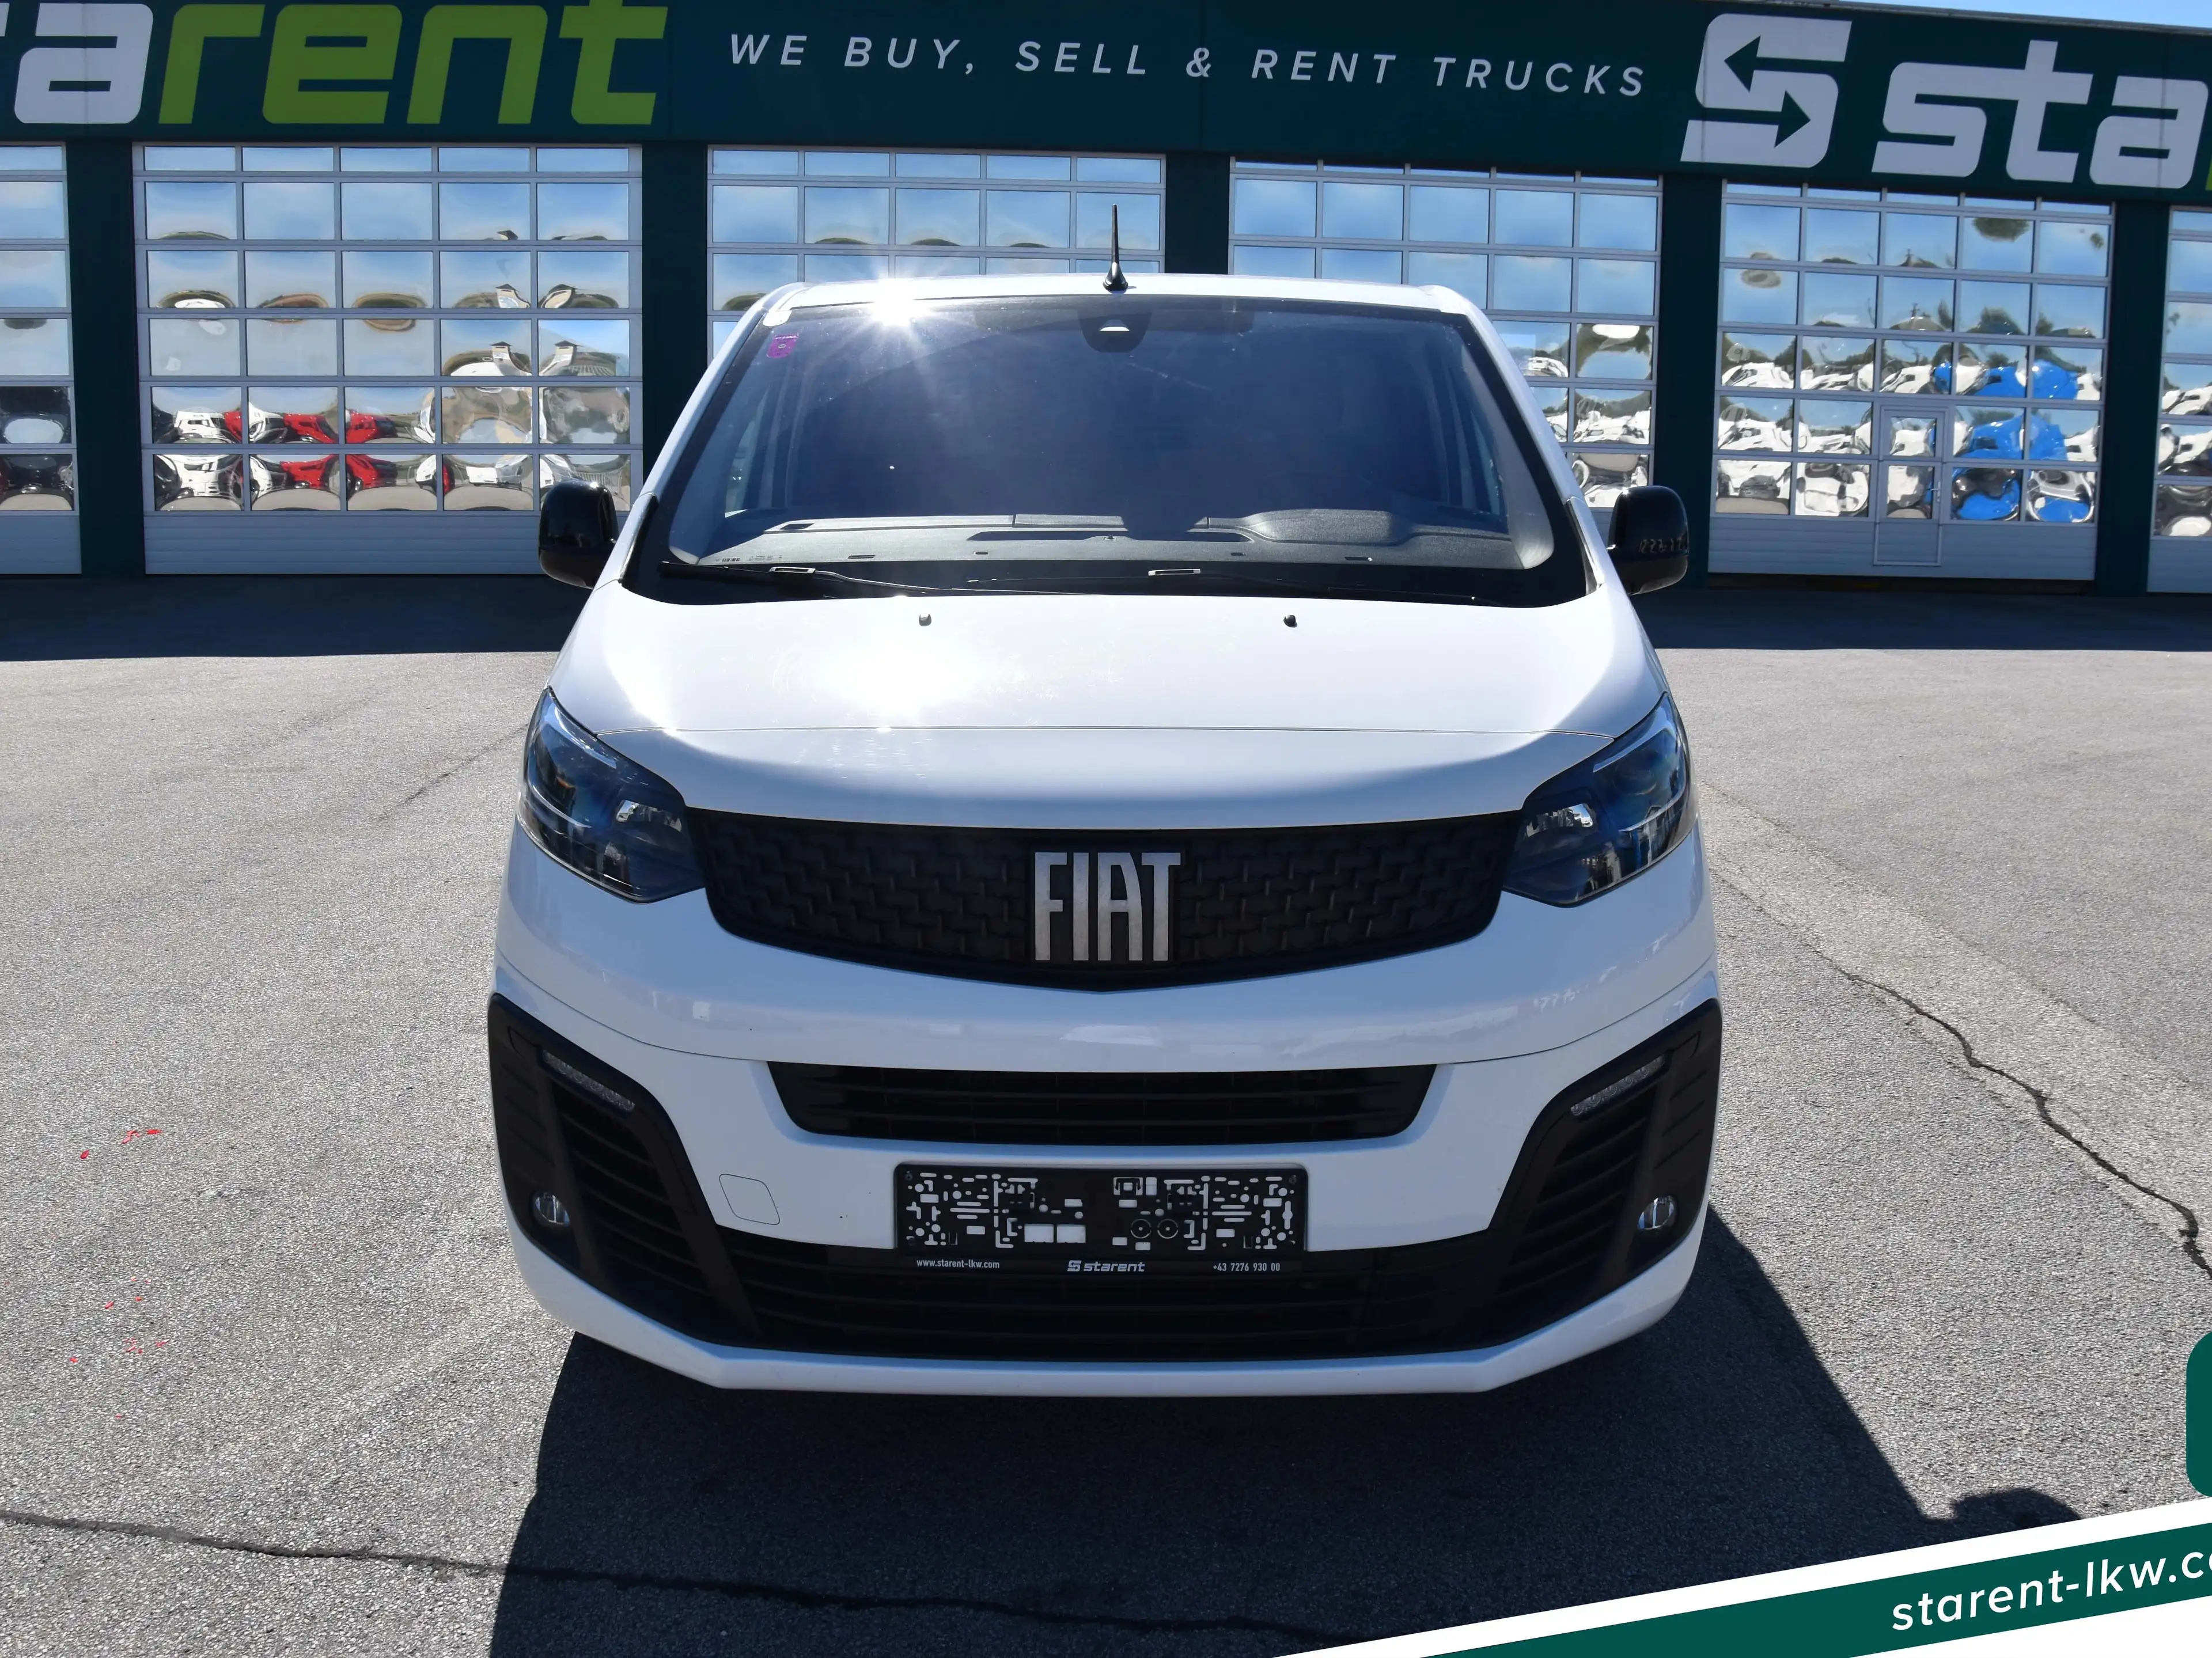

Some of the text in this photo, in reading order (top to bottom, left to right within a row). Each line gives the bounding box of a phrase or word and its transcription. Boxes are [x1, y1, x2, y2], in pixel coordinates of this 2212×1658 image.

[0, 0, 668, 124] arent
[730, 34, 1644, 97] WE BUY, SELL & RENT TRUCKS
[1871, 39, 2212, 190] sta
[1035, 852, 1181, 961] FIAT
[916, 1258, 1001, 1269] www.starent-lkw.com
[1083, 1261, 1145, 1272] starent
[1213, 1262, 1281, 1272] +43 7276 930 00
